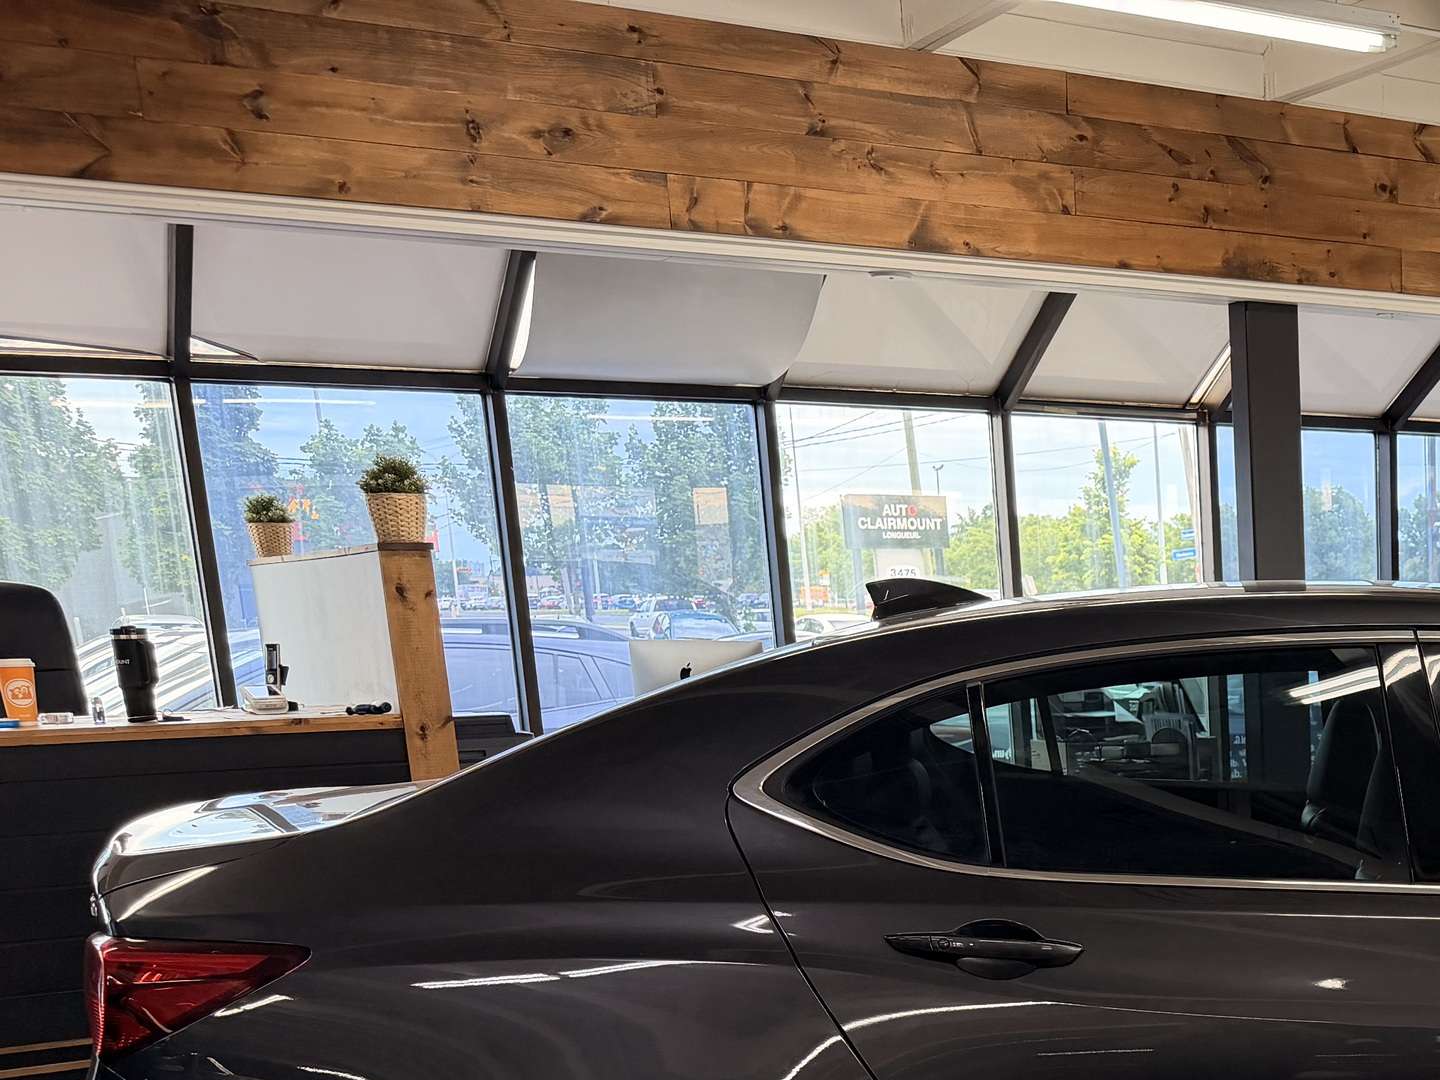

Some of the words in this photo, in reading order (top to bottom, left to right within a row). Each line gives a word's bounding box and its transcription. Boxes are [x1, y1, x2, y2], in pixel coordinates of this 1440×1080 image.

[882, 504, 918, 517] AUTO
[857, 517, 942, 530] CLAIRMOUNT
[889, 568, 917, 577] 3475
